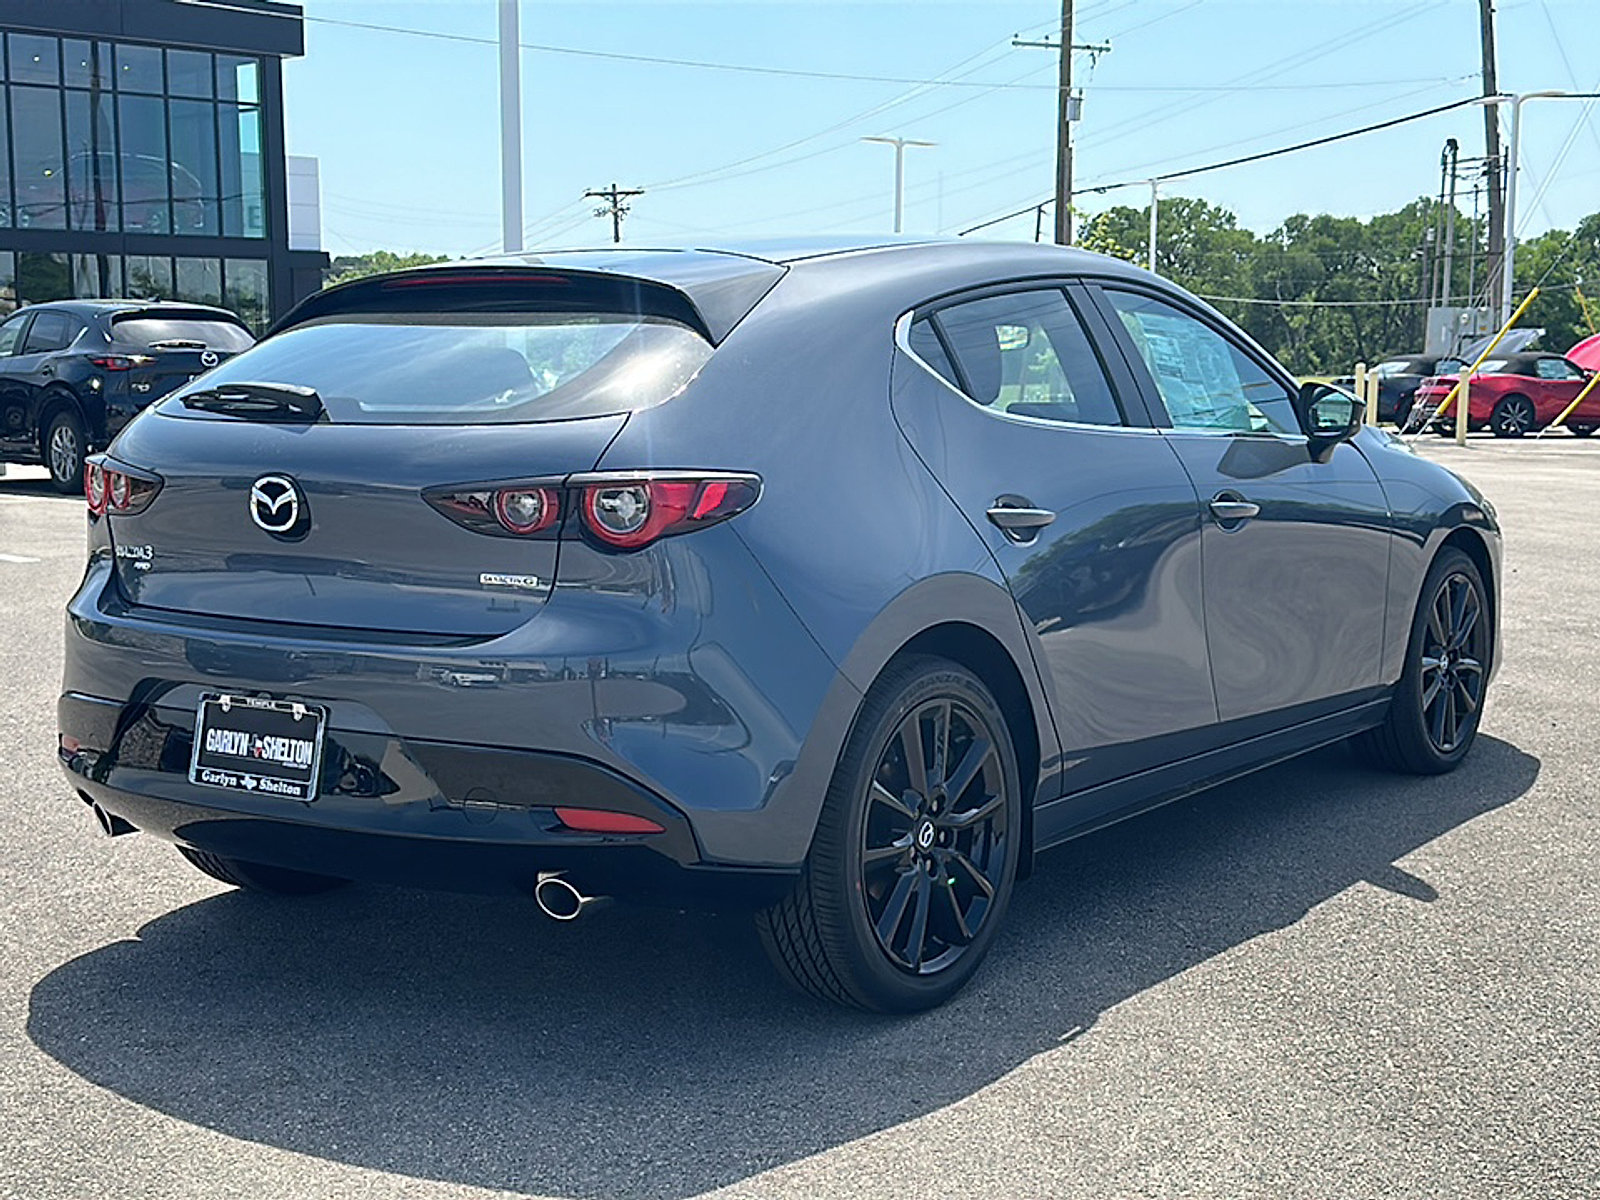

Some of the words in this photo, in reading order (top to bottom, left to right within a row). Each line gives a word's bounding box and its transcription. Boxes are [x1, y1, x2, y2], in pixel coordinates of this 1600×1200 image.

[206, 728, 249, 756] GARLYN
[262, 735, 313, 765] SHELTON
[201, 769, 237, 787] Garlyn
[259, 778, 301, 796] Shelton
